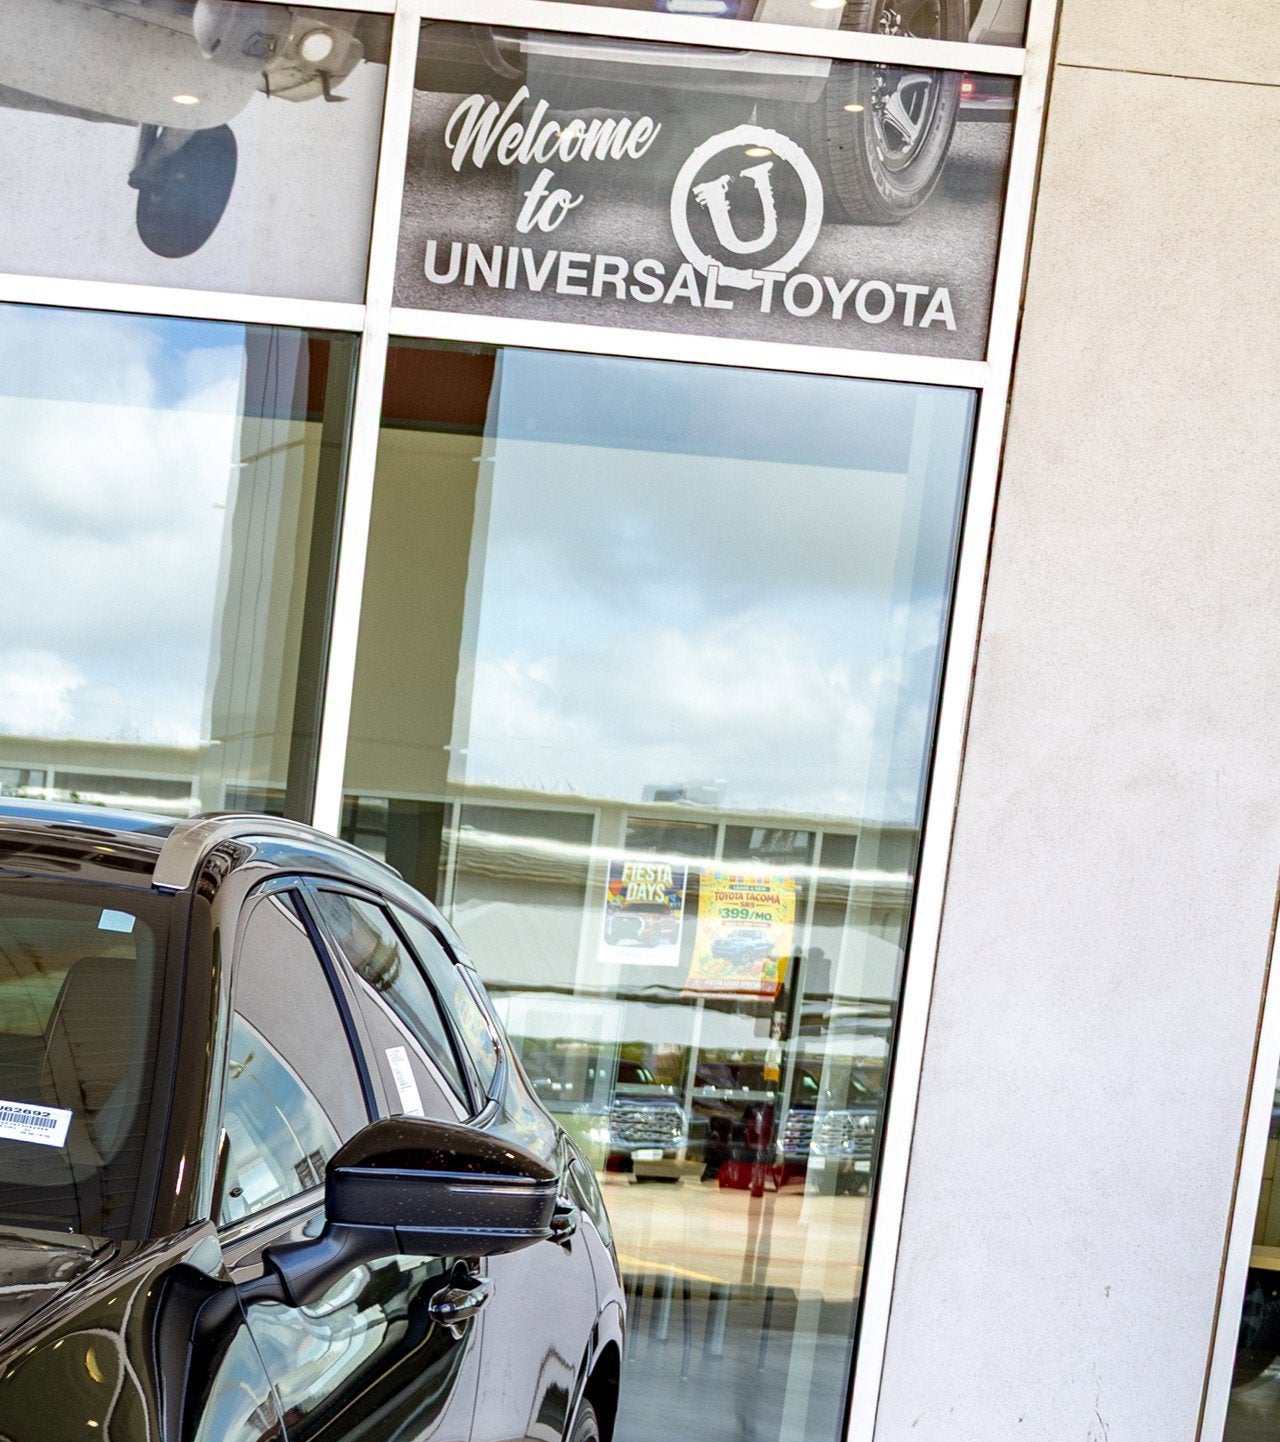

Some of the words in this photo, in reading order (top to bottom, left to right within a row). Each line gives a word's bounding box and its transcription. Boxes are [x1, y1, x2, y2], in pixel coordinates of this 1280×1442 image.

[444, 86, 661, 172] Welcome
[516, 168, 583, 234] to
[423, 239, 734, 310] UNIVERSAL
[751, 269, 957, 331] TOYOTA
[621, 861, 673, 885] FIESTA
[626, 882, 667, 903] DAYS
[714, 891, 744, 902] TOYOTA
[745, 892, 781, 905] TACOMA
